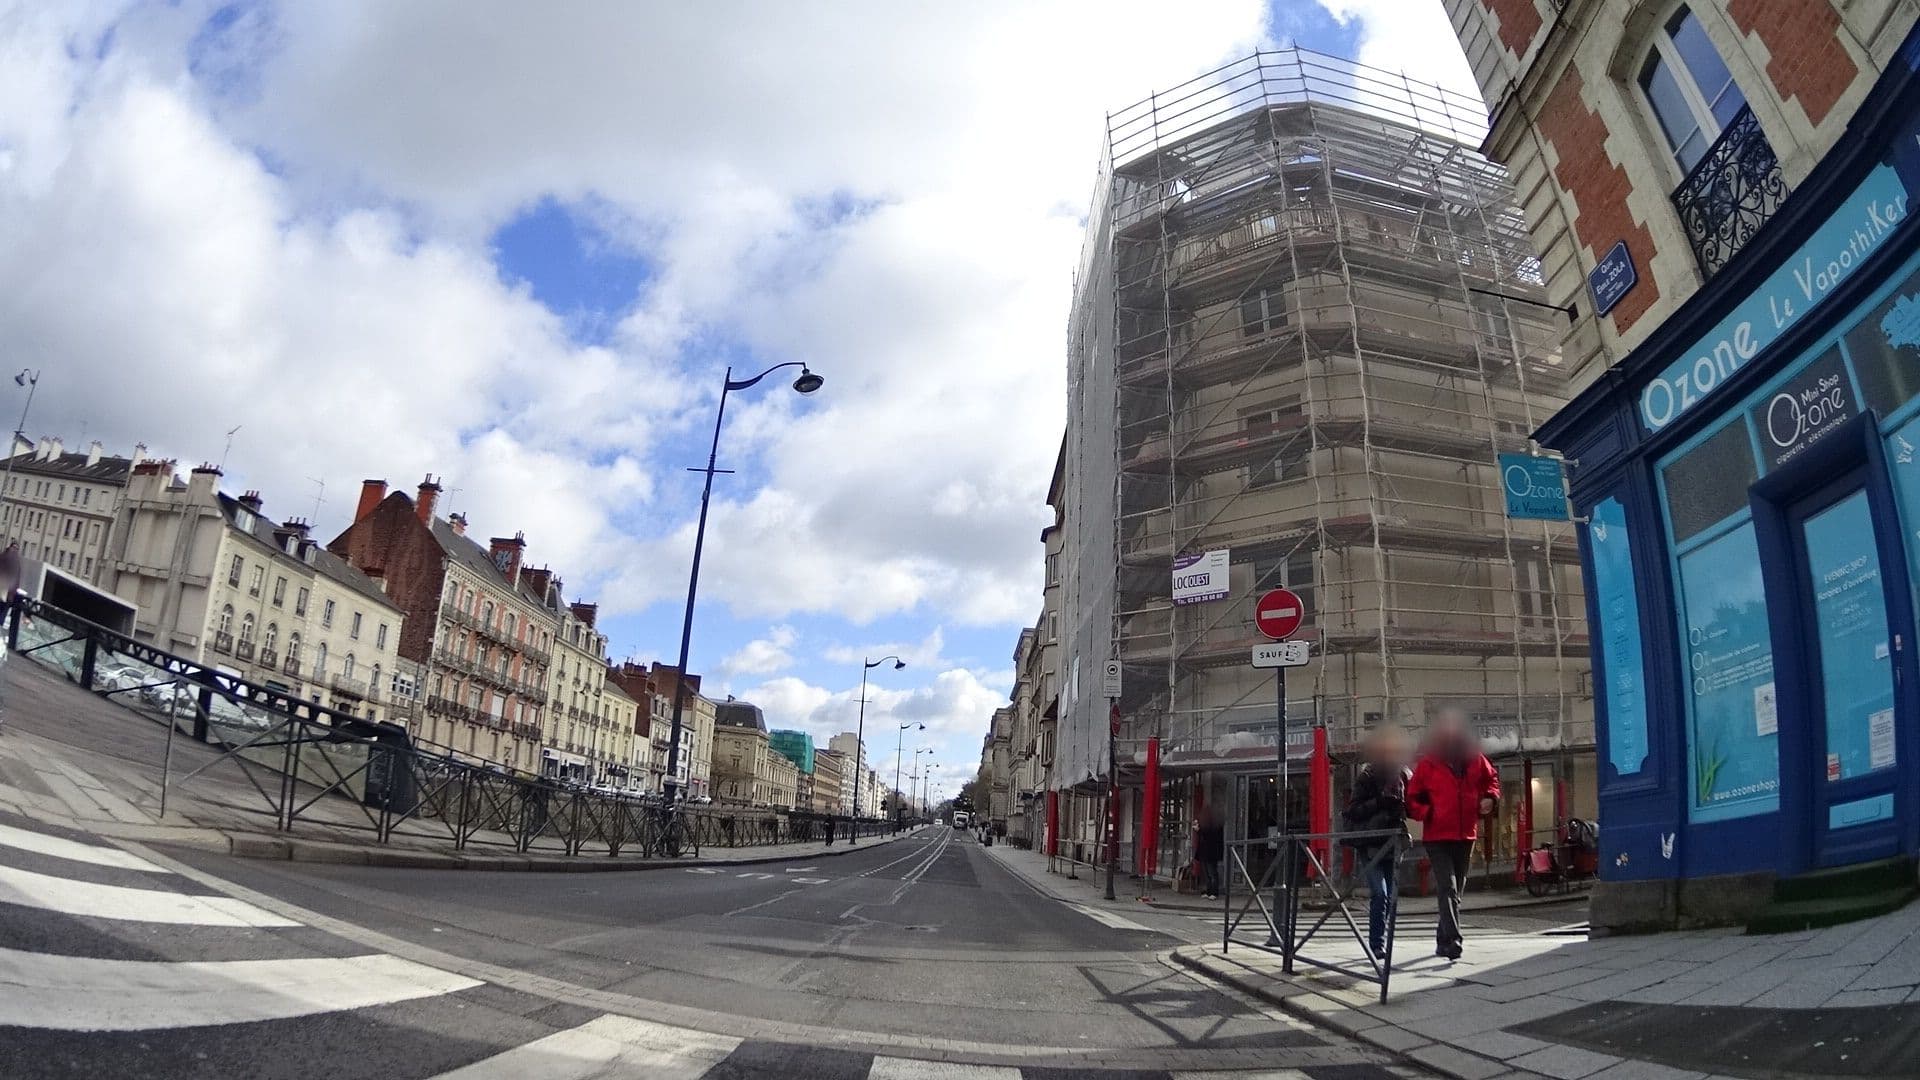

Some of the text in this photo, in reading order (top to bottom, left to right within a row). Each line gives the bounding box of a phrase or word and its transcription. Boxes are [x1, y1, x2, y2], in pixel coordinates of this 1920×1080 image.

[1609, 261, 1626, 281] ZOLA
[1644, 321, 1759, 427] Ozone
[1769, 296, 1794, 330] Le
[1819, 374, 1839, 392] Shop
[1767, 387, 1845, 447] Ozone
[1505, 465, 1564, 499] Ozone
[1260, 650, 1283, 659] SAUF
